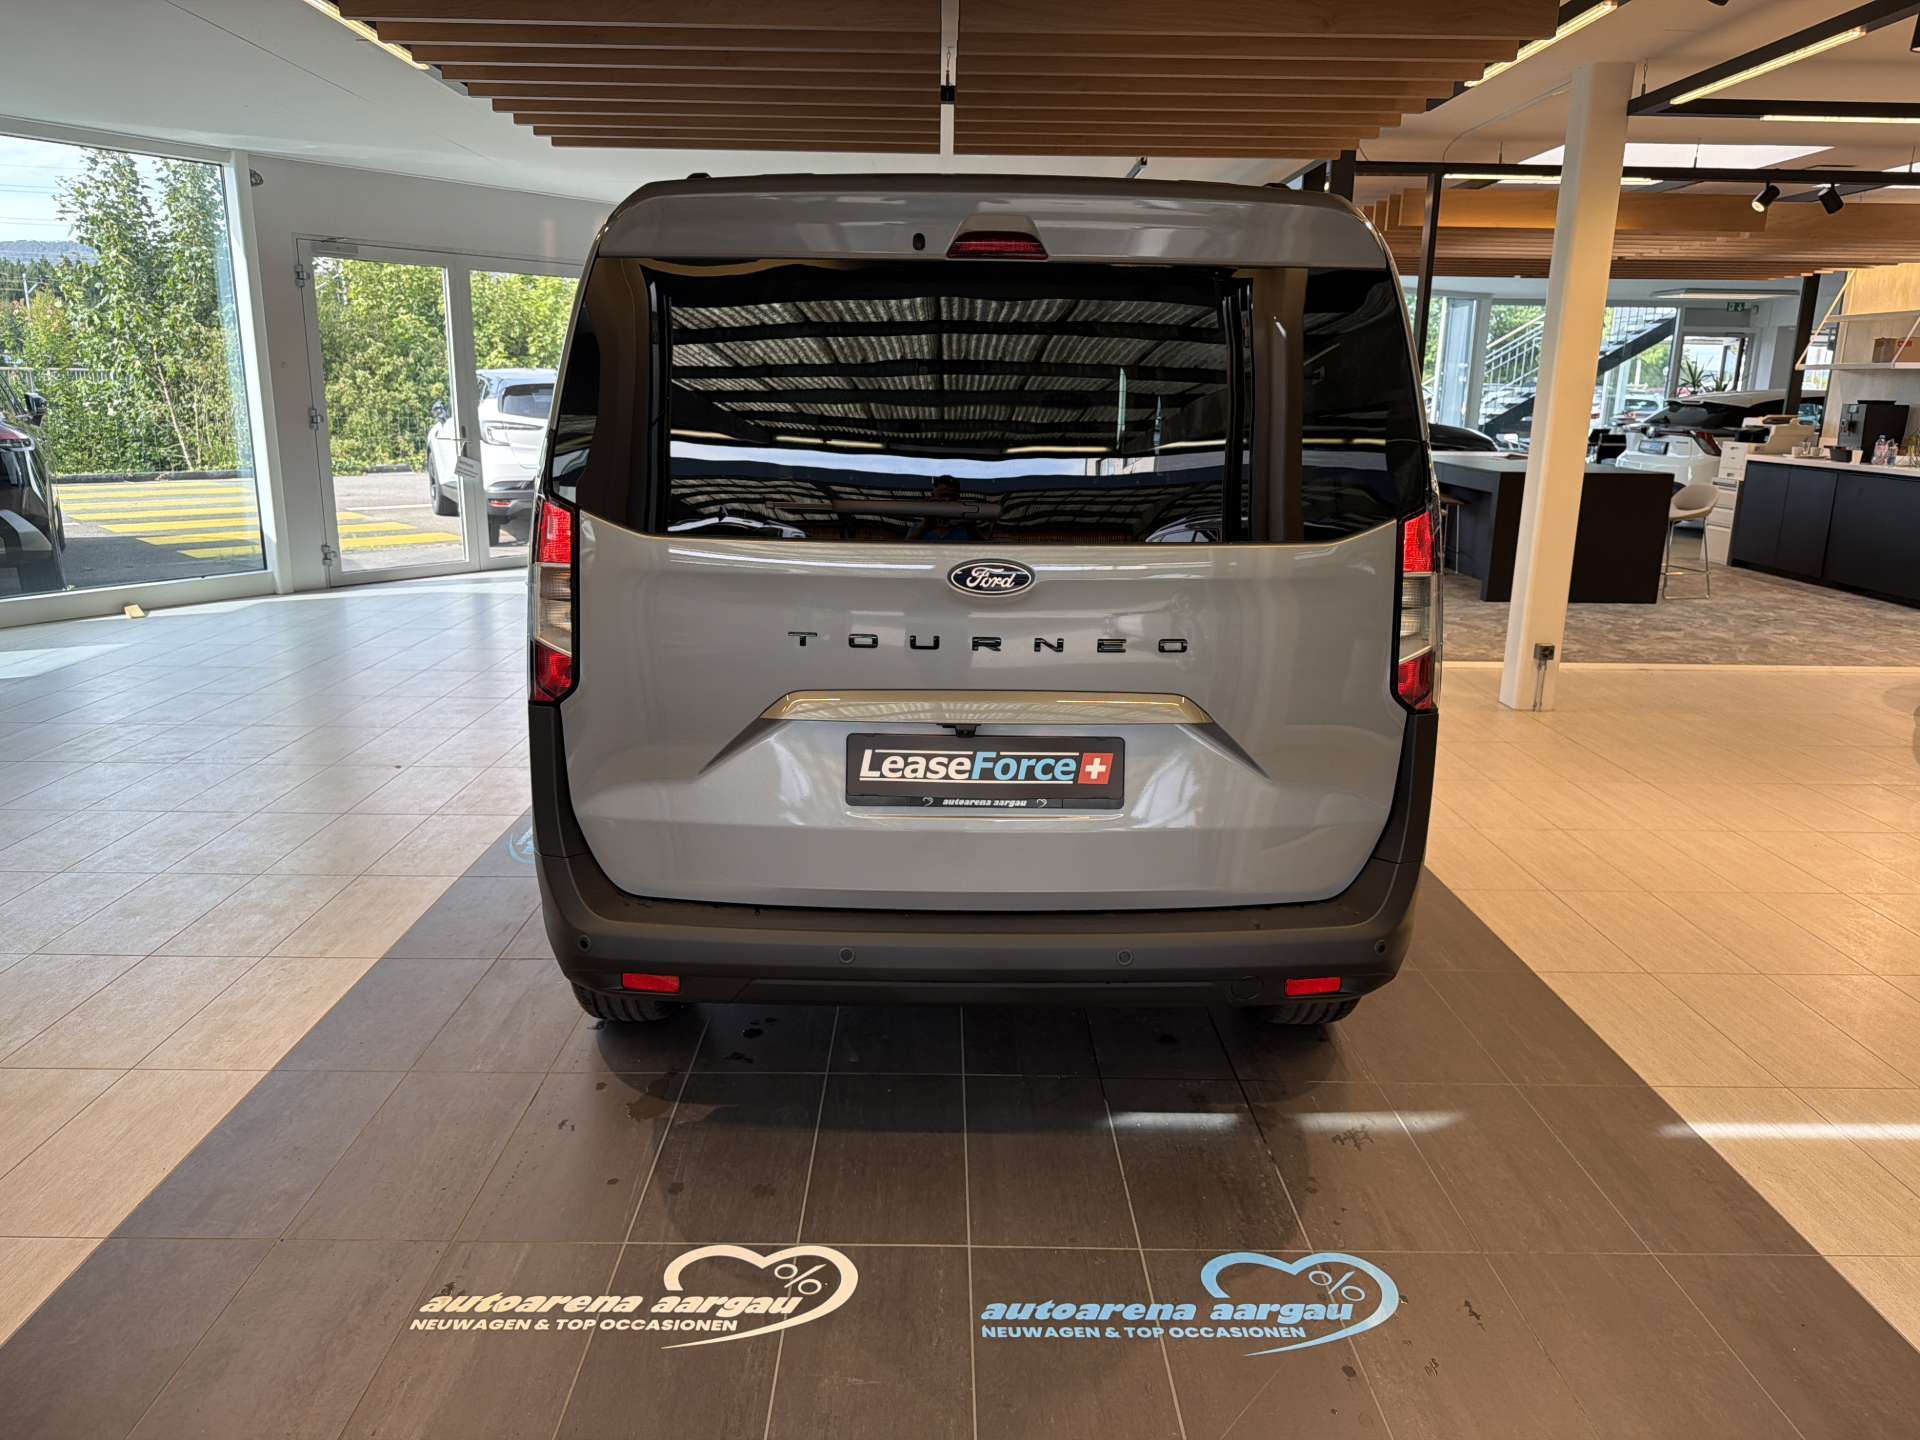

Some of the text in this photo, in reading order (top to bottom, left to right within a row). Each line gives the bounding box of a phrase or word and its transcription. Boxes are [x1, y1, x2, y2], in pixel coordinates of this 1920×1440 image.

[966, 567, 1016, 588] Ford
[787, 631, 1188, 653] TOURNEO
[859, 749, 1077, 781] LeaseForce
[942, 798, 1027, 807] autoarena aargau
[419, 1292, 803, 1318] autoarena aargau
[980, 1300, 1354, 1324] autoarena aargau
[410, 1318, 738, 1332] NEUWAGEN & TOP OCCASIONEN
[981, 1325, 1306, 1339] NEUWAGEN & TOP OCCASIONEN
